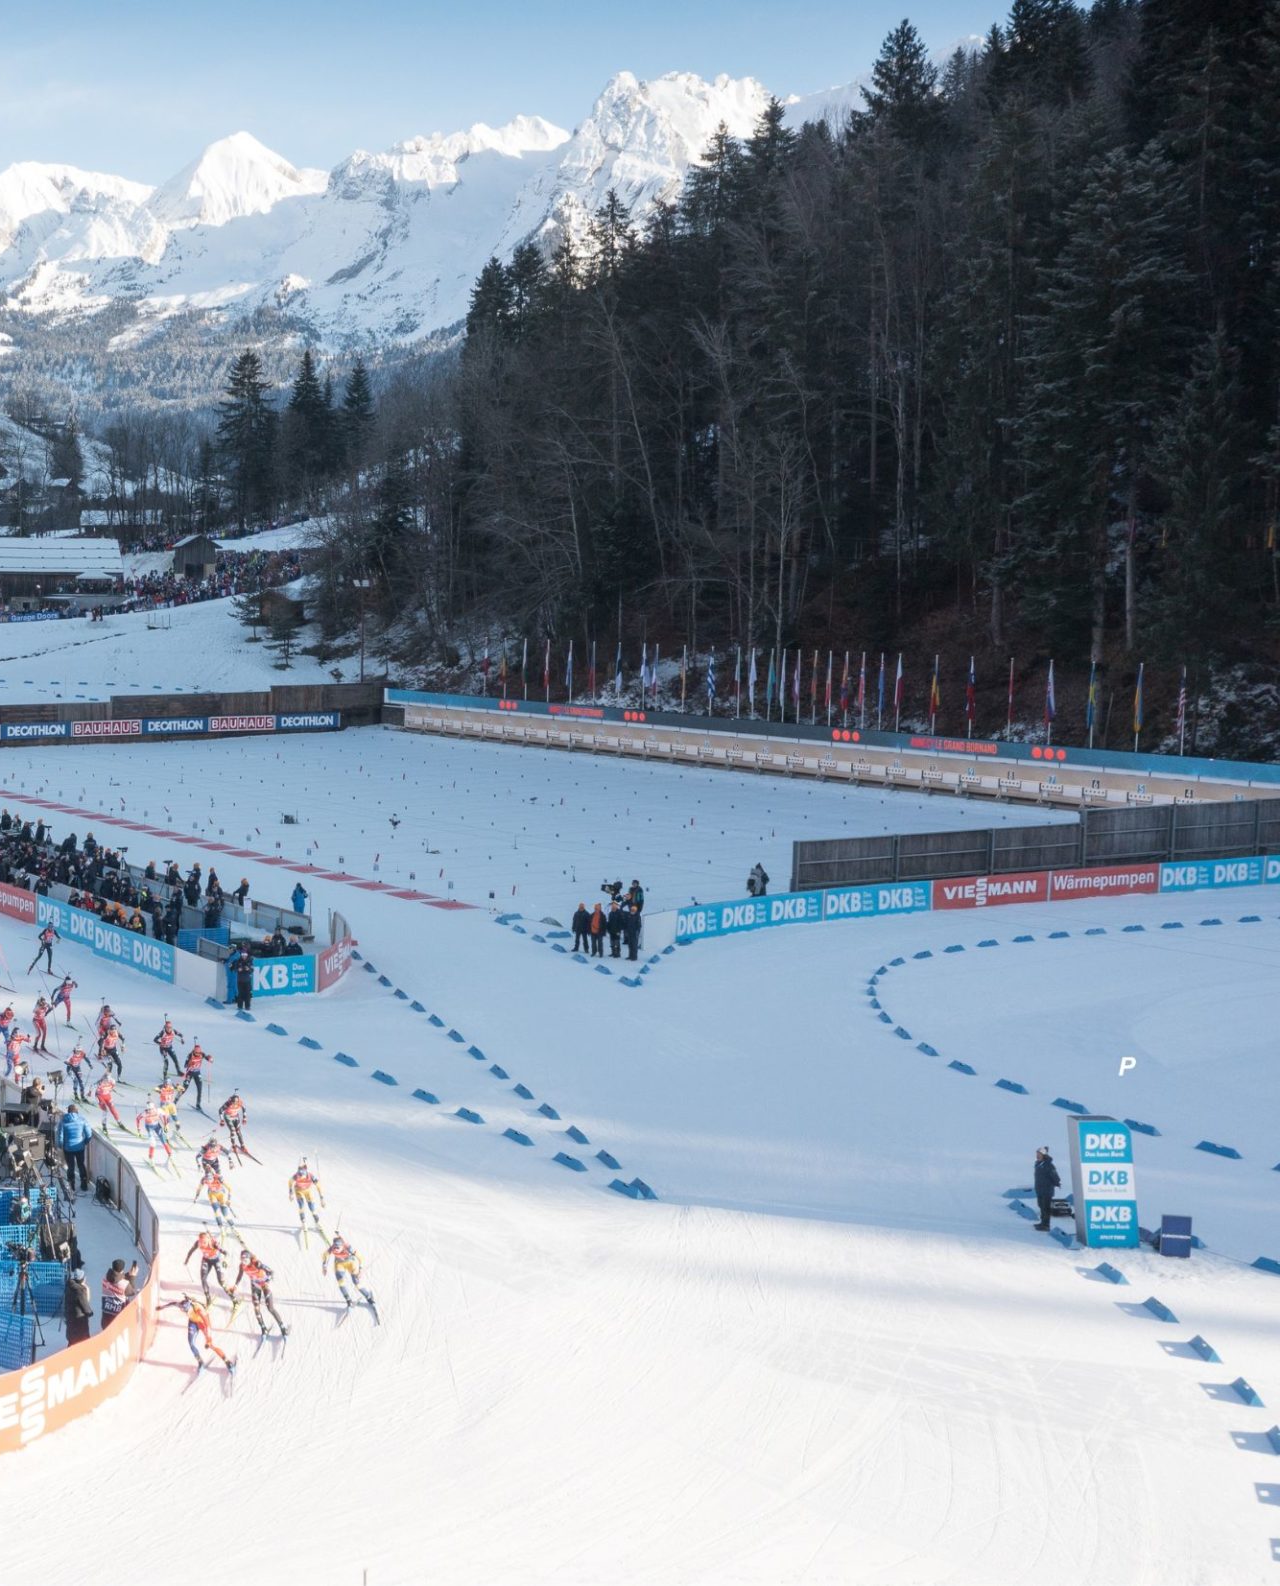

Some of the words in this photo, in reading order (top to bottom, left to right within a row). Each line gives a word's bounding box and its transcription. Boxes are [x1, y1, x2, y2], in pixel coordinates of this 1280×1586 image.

[7, 724, 66, 737] DECATHLON
[74, 721, 140, 735] BAUHAUS
[148, 719, 203, 732] DECATHLON
[211, 717, 273, 730] BAUHAUS
[281, 715, 334, 728] DECATHLON
[1054, 871, 1154, 891] Wärmepumpen
[1162, 866, 1197, 887] DKB
[1214, 863, 1249, 883] DKB
[878, 888, 913, 911] DKB
[943, 878, 1037, 906] VIESSMANN
[771, 897, 806, 921] DKB
[826, 892, 861, 915] DKB
[38, 901, 60, 928] DKB
[677, 911, 706, 937] DKB
[722, 904, 755, 929] DKB
[70, 912, 94, 940] DKB
[95, 927, 121, 956] DKB
[133, 940, 161, 970] DKB
[292, 962, 305, 971] Das
[252, 964, 289, 991] KB
[1085, 1133, 1126, 1150] DKB
[1088, 1170, 1129, 1186] DKB
[1090, 1206, 1132, 1223] DKB
